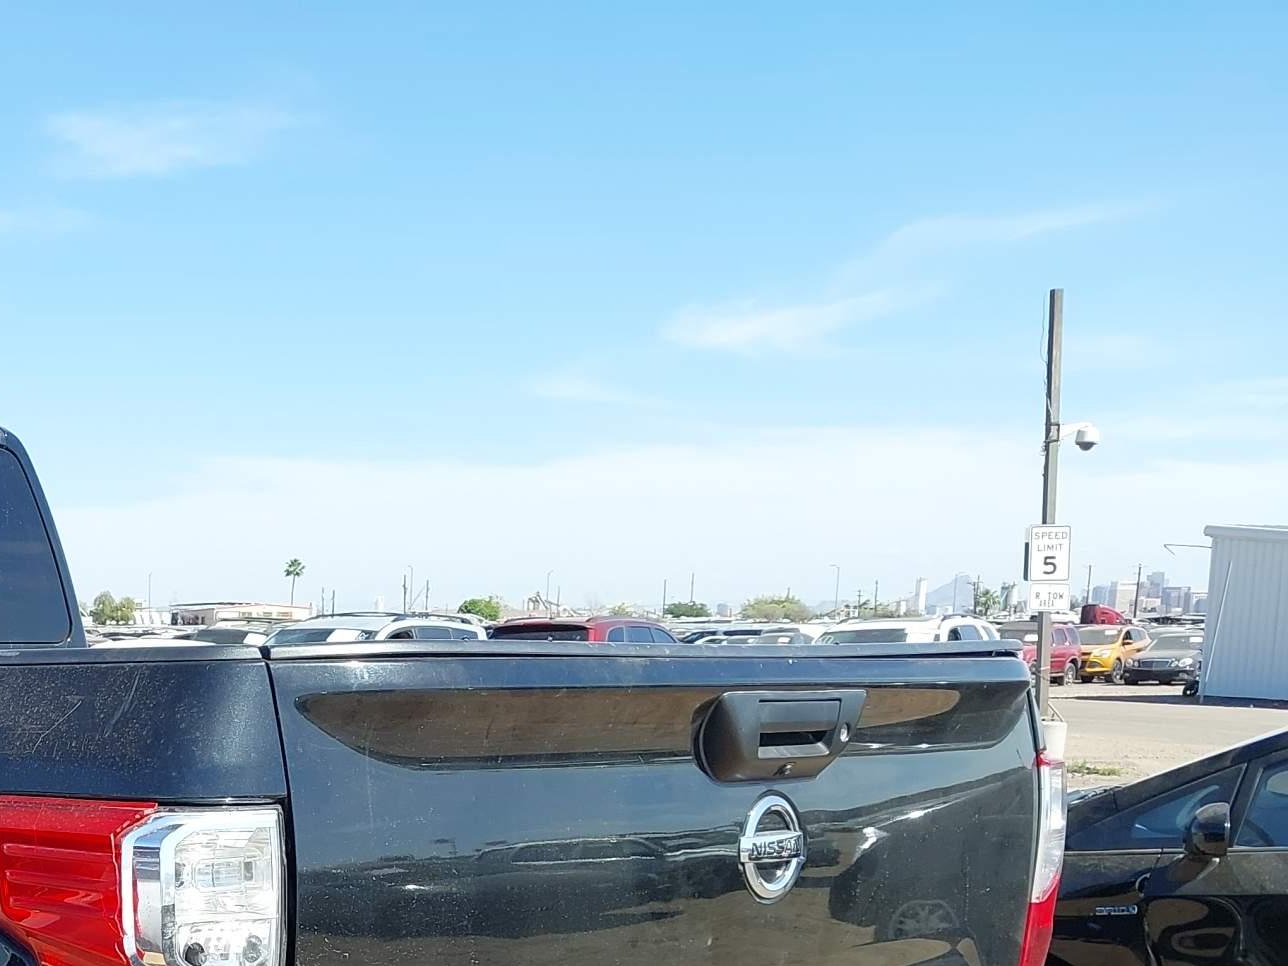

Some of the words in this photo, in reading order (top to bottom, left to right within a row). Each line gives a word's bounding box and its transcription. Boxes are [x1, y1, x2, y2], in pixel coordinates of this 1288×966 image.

[1034, 531, 1068, 540] SPEED
[1036, 543, 1064, 552] LIMIT
[1042, 555, 1057, 575] 5
[751, 839, 801, 857] NISSAN
